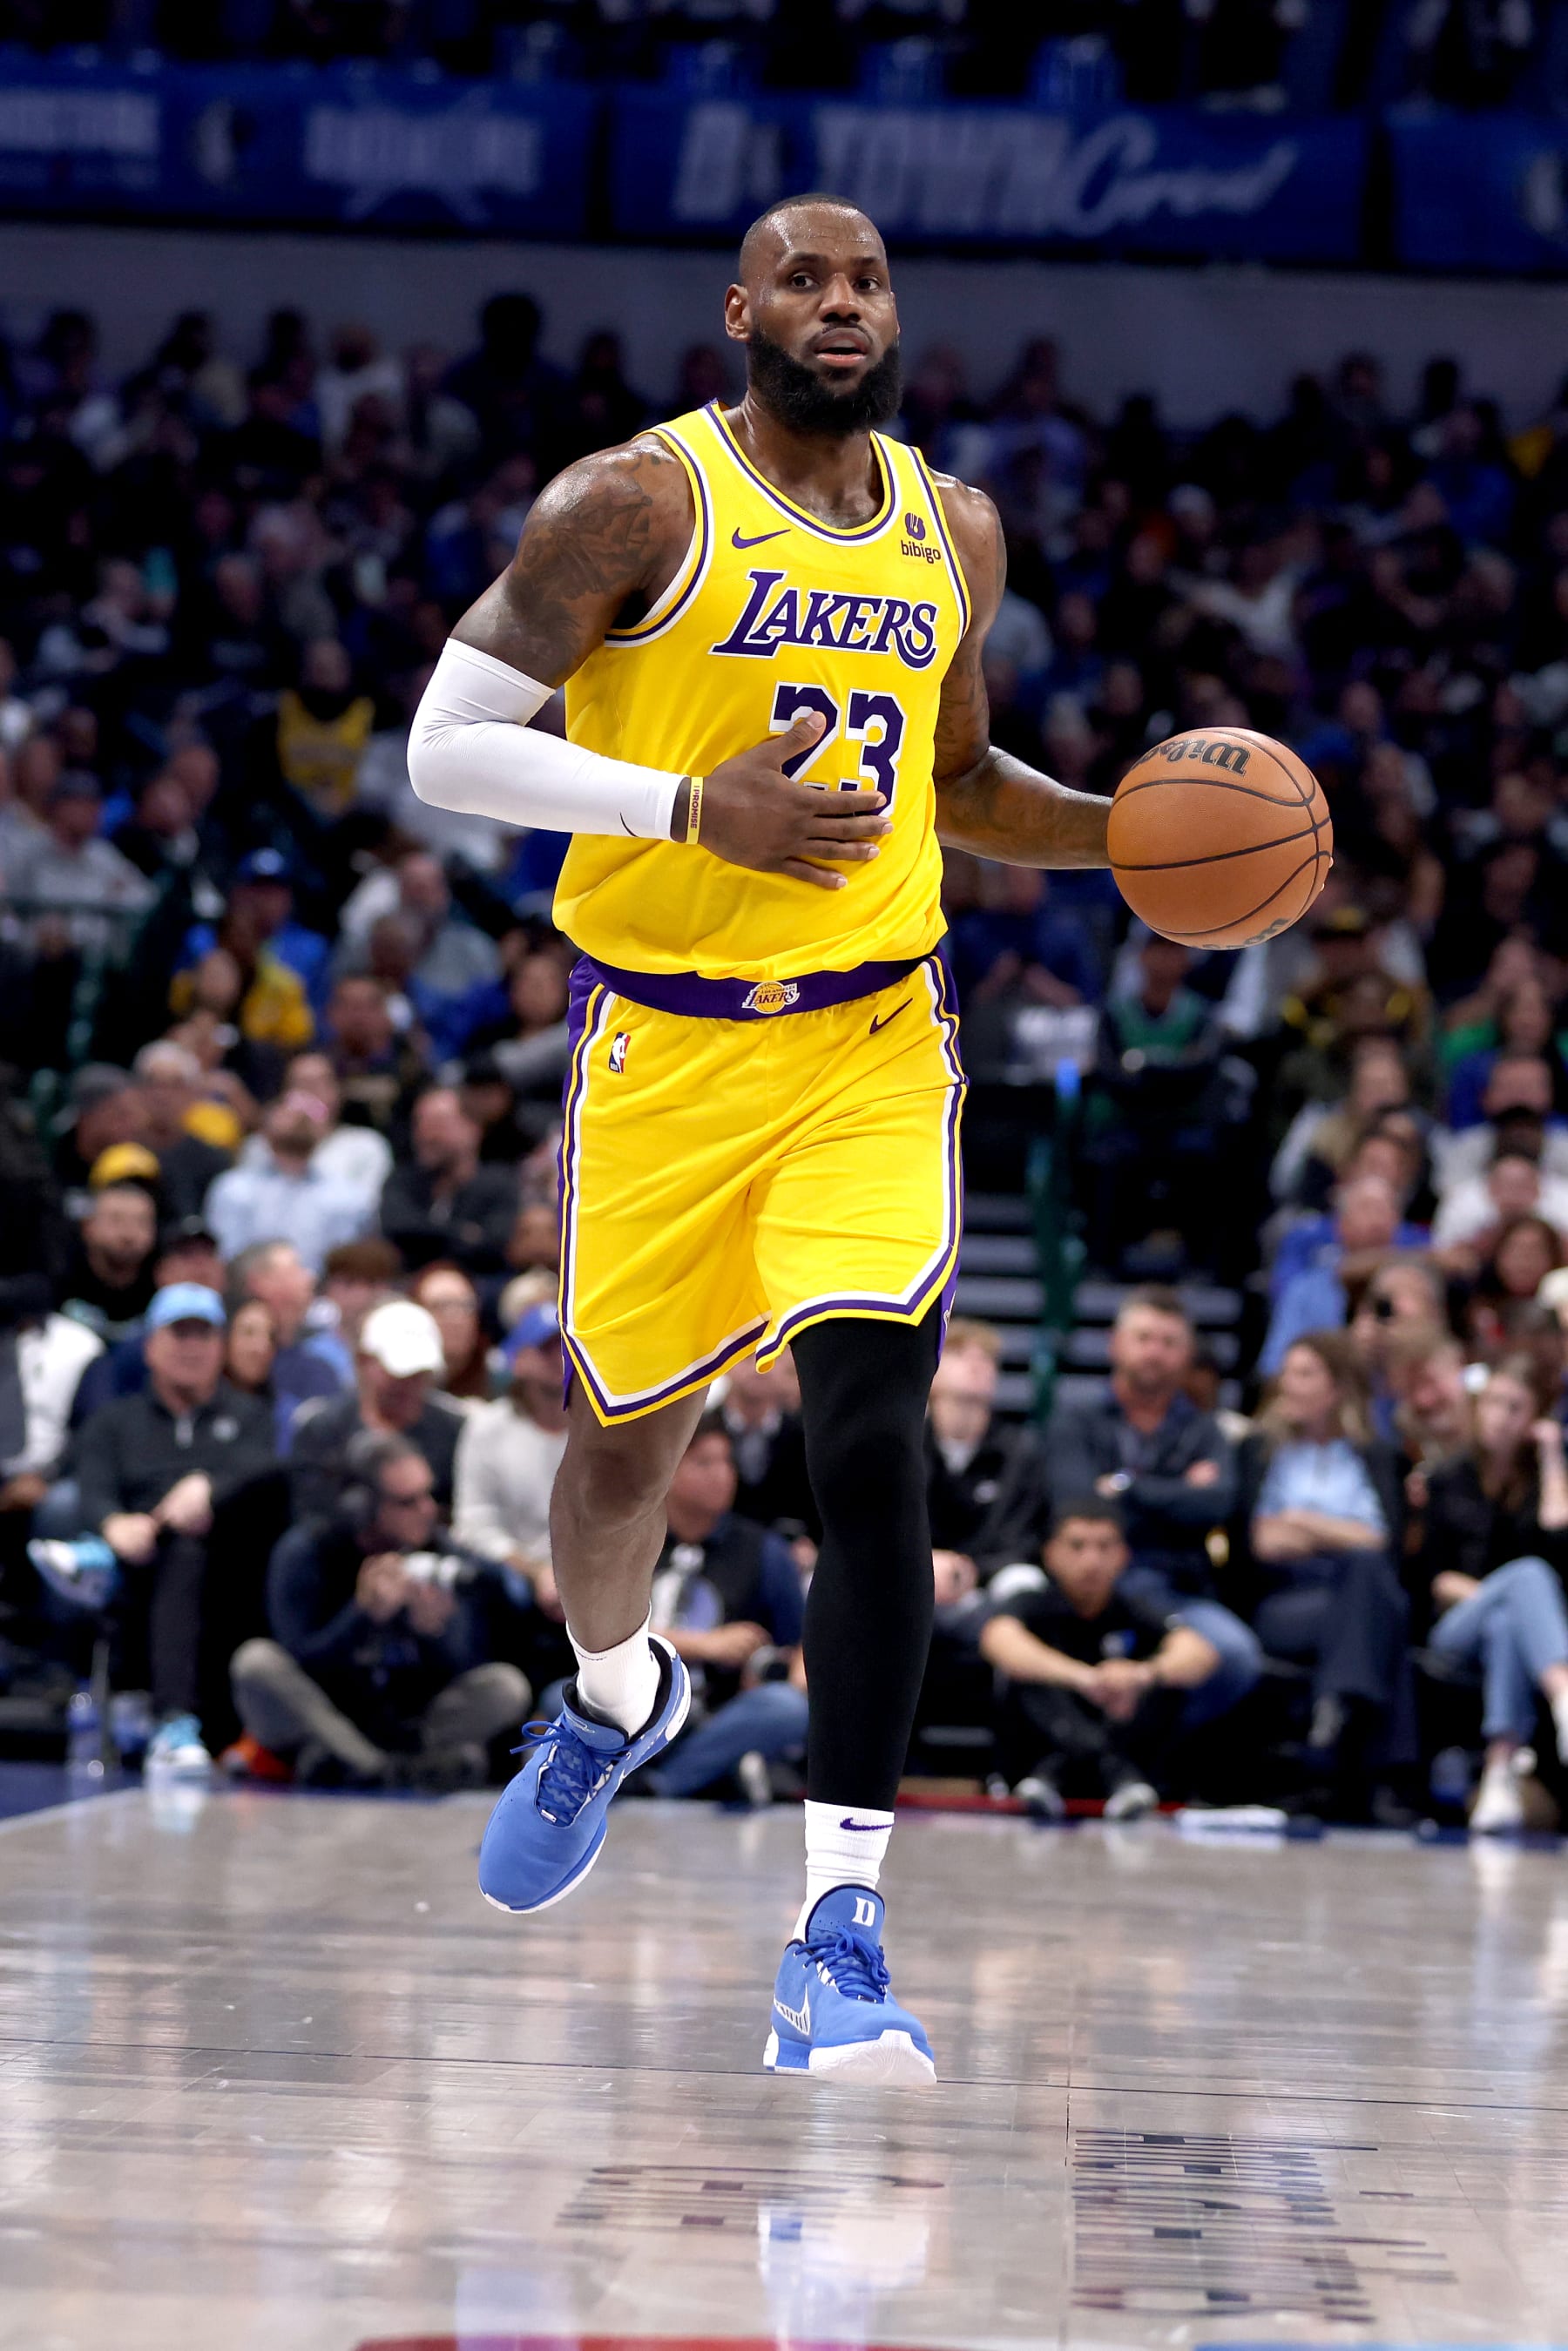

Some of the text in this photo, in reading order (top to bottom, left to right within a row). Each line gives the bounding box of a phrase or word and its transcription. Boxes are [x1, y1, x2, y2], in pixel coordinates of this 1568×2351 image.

[900, 540, 942, 564] bibigo
[707, 568, 940, 672] LAKERS
[769, 681, 906, 818] 23
[690, 789, 700, 829] PROMISE
[742, 990, 799, 1009] LAKERS
[851, 1896, 876, 1927] D
